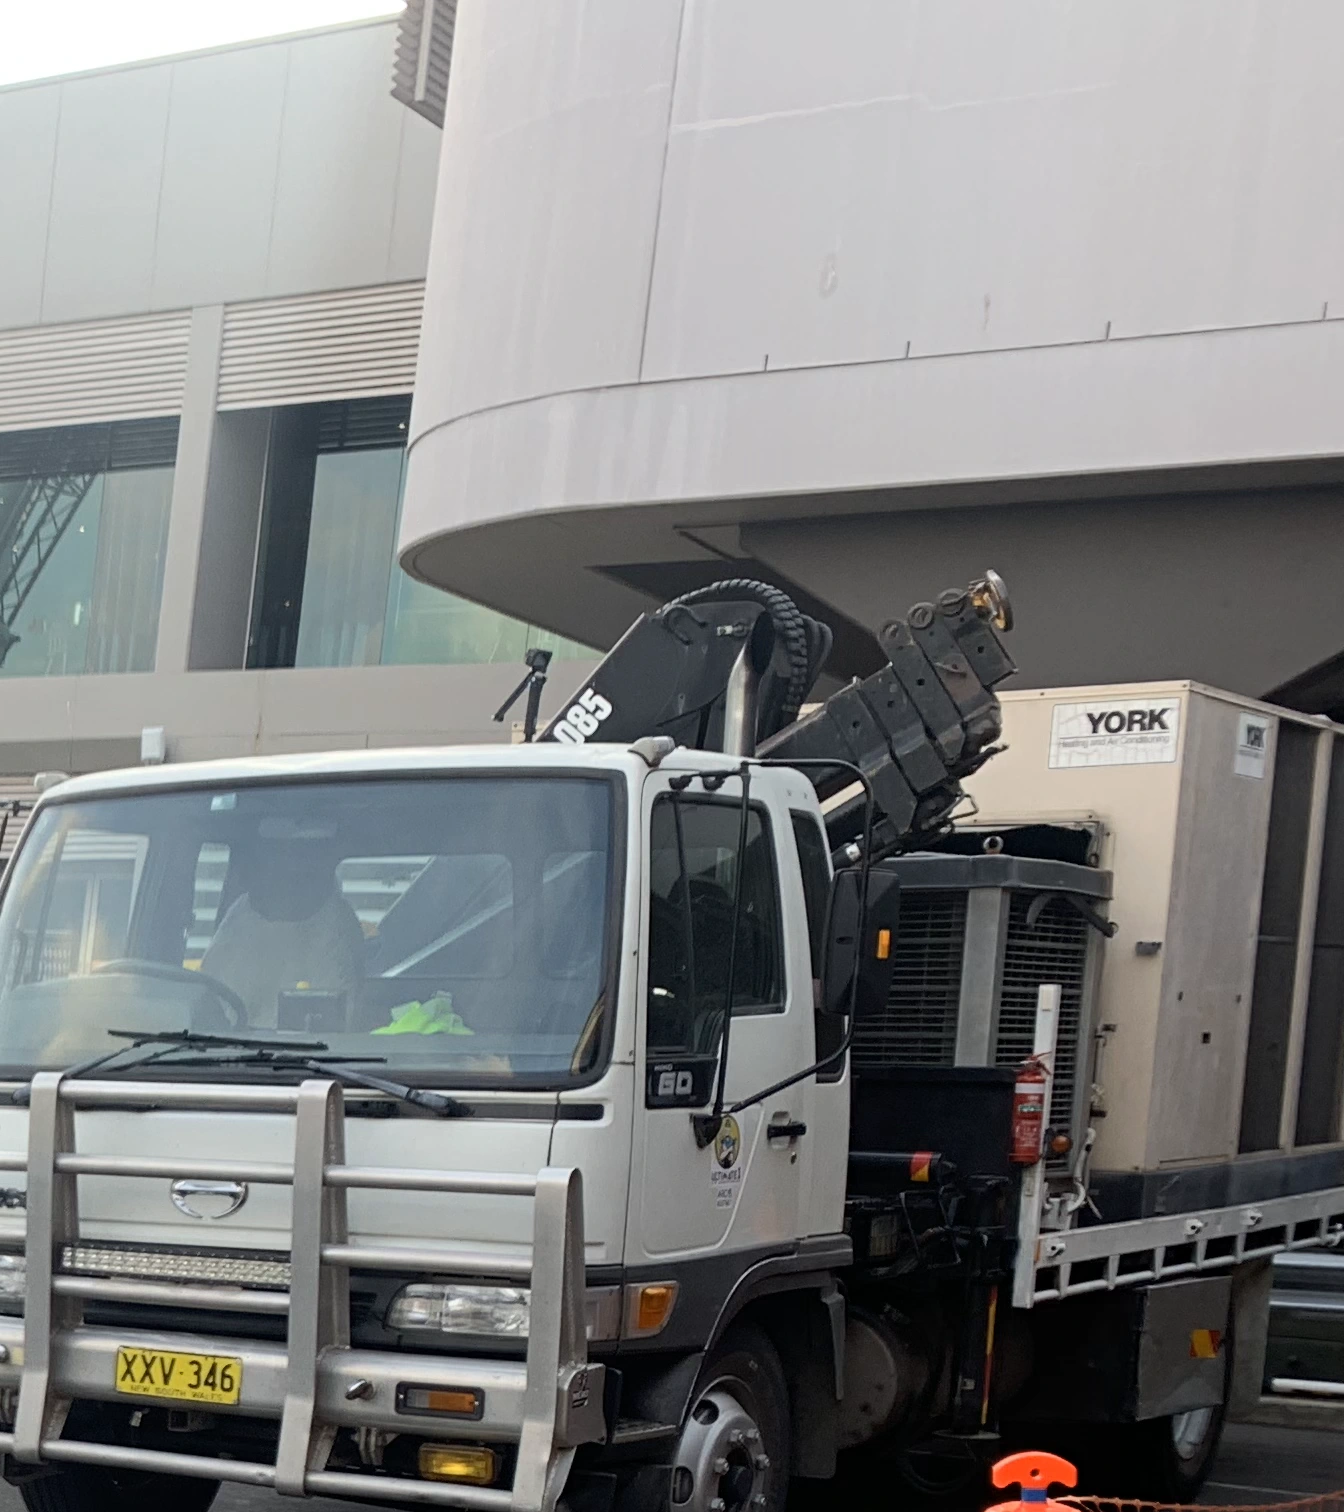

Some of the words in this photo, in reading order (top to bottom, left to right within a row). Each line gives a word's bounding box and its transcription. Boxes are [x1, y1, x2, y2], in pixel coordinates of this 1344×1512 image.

[1086, 707, 1171, 734] YORK
[1058, 739, 1089, 749] Heating
[1090, 738, 1106, 746] and
[1107, 737, 1119, 745] Air
[1121, 734, 1170, 745] Conditioning
[658, 1071, 694, 1096] GD
[130, 1384, 150, 1392] NEW
[155, 1386, 187, 1397] SOUTH
